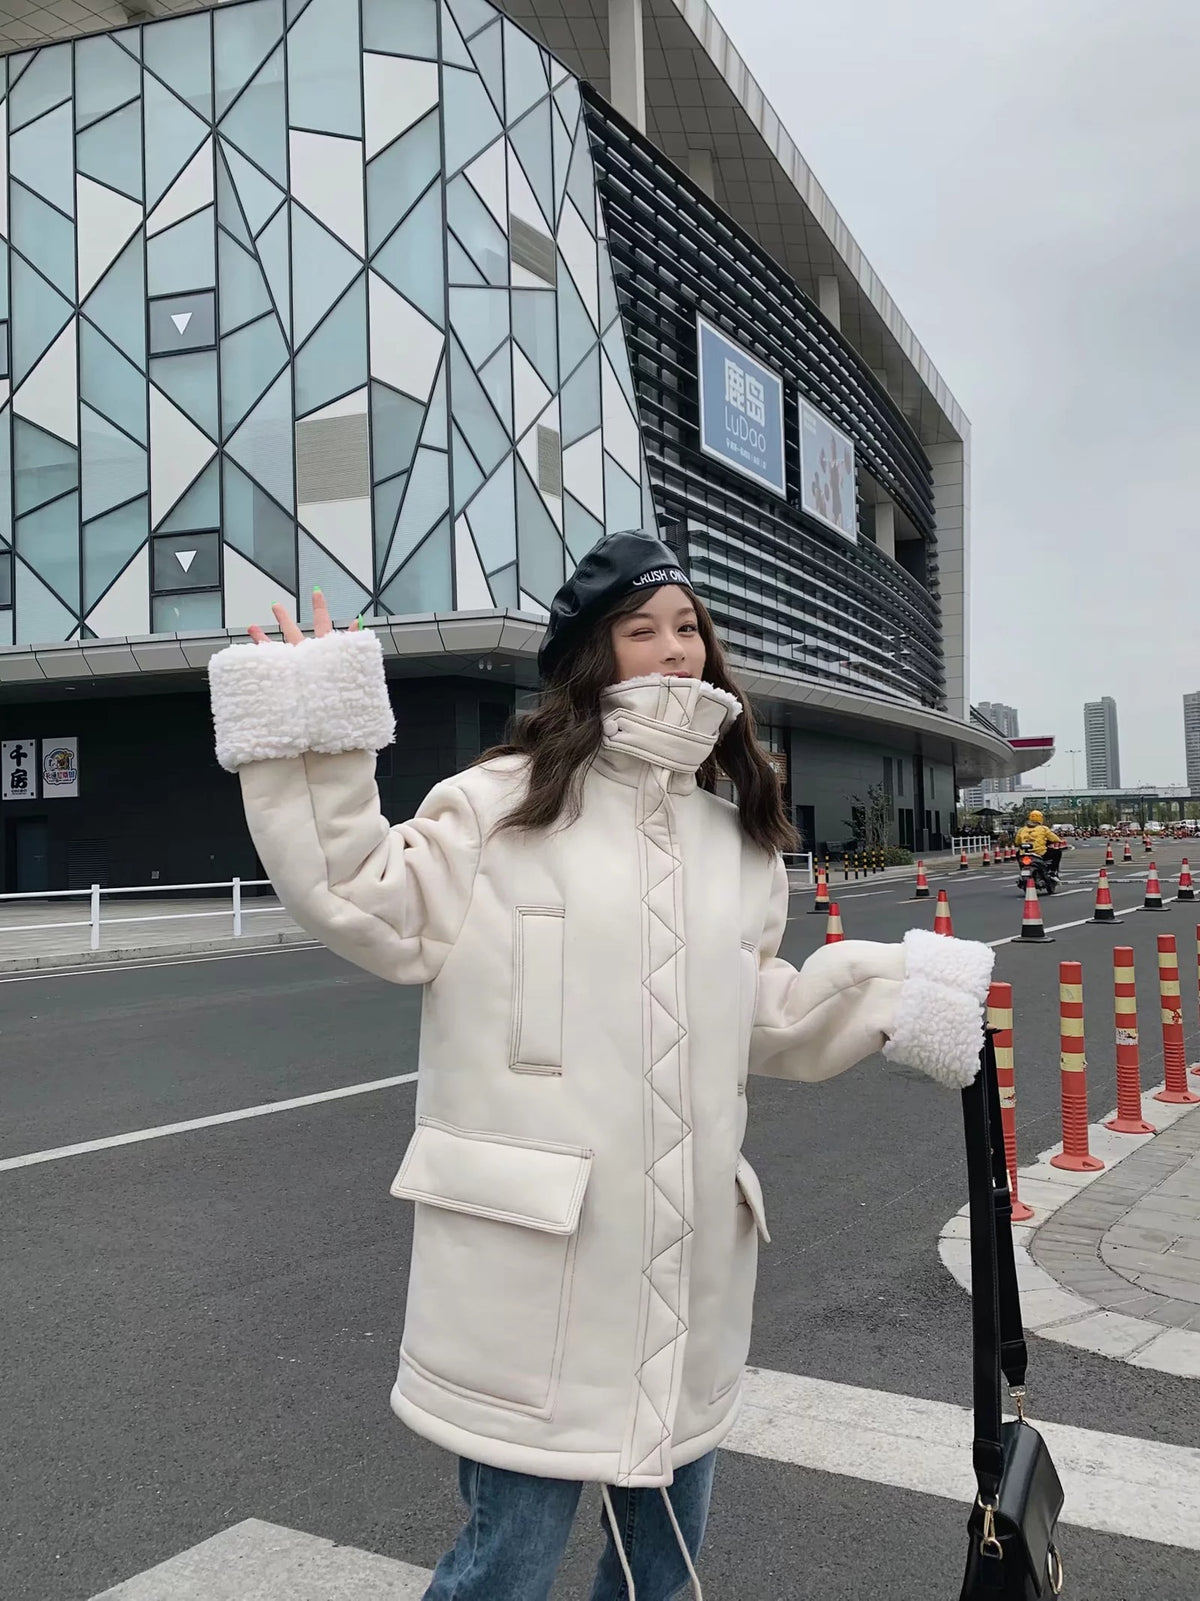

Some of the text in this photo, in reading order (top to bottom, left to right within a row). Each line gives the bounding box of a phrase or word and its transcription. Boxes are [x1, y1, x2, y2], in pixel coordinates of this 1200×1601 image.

[725, 357, 765, 427] 鹿岛
[725, 405, 766, 453] LuDao
[10, 744, 28, 789] 千房
